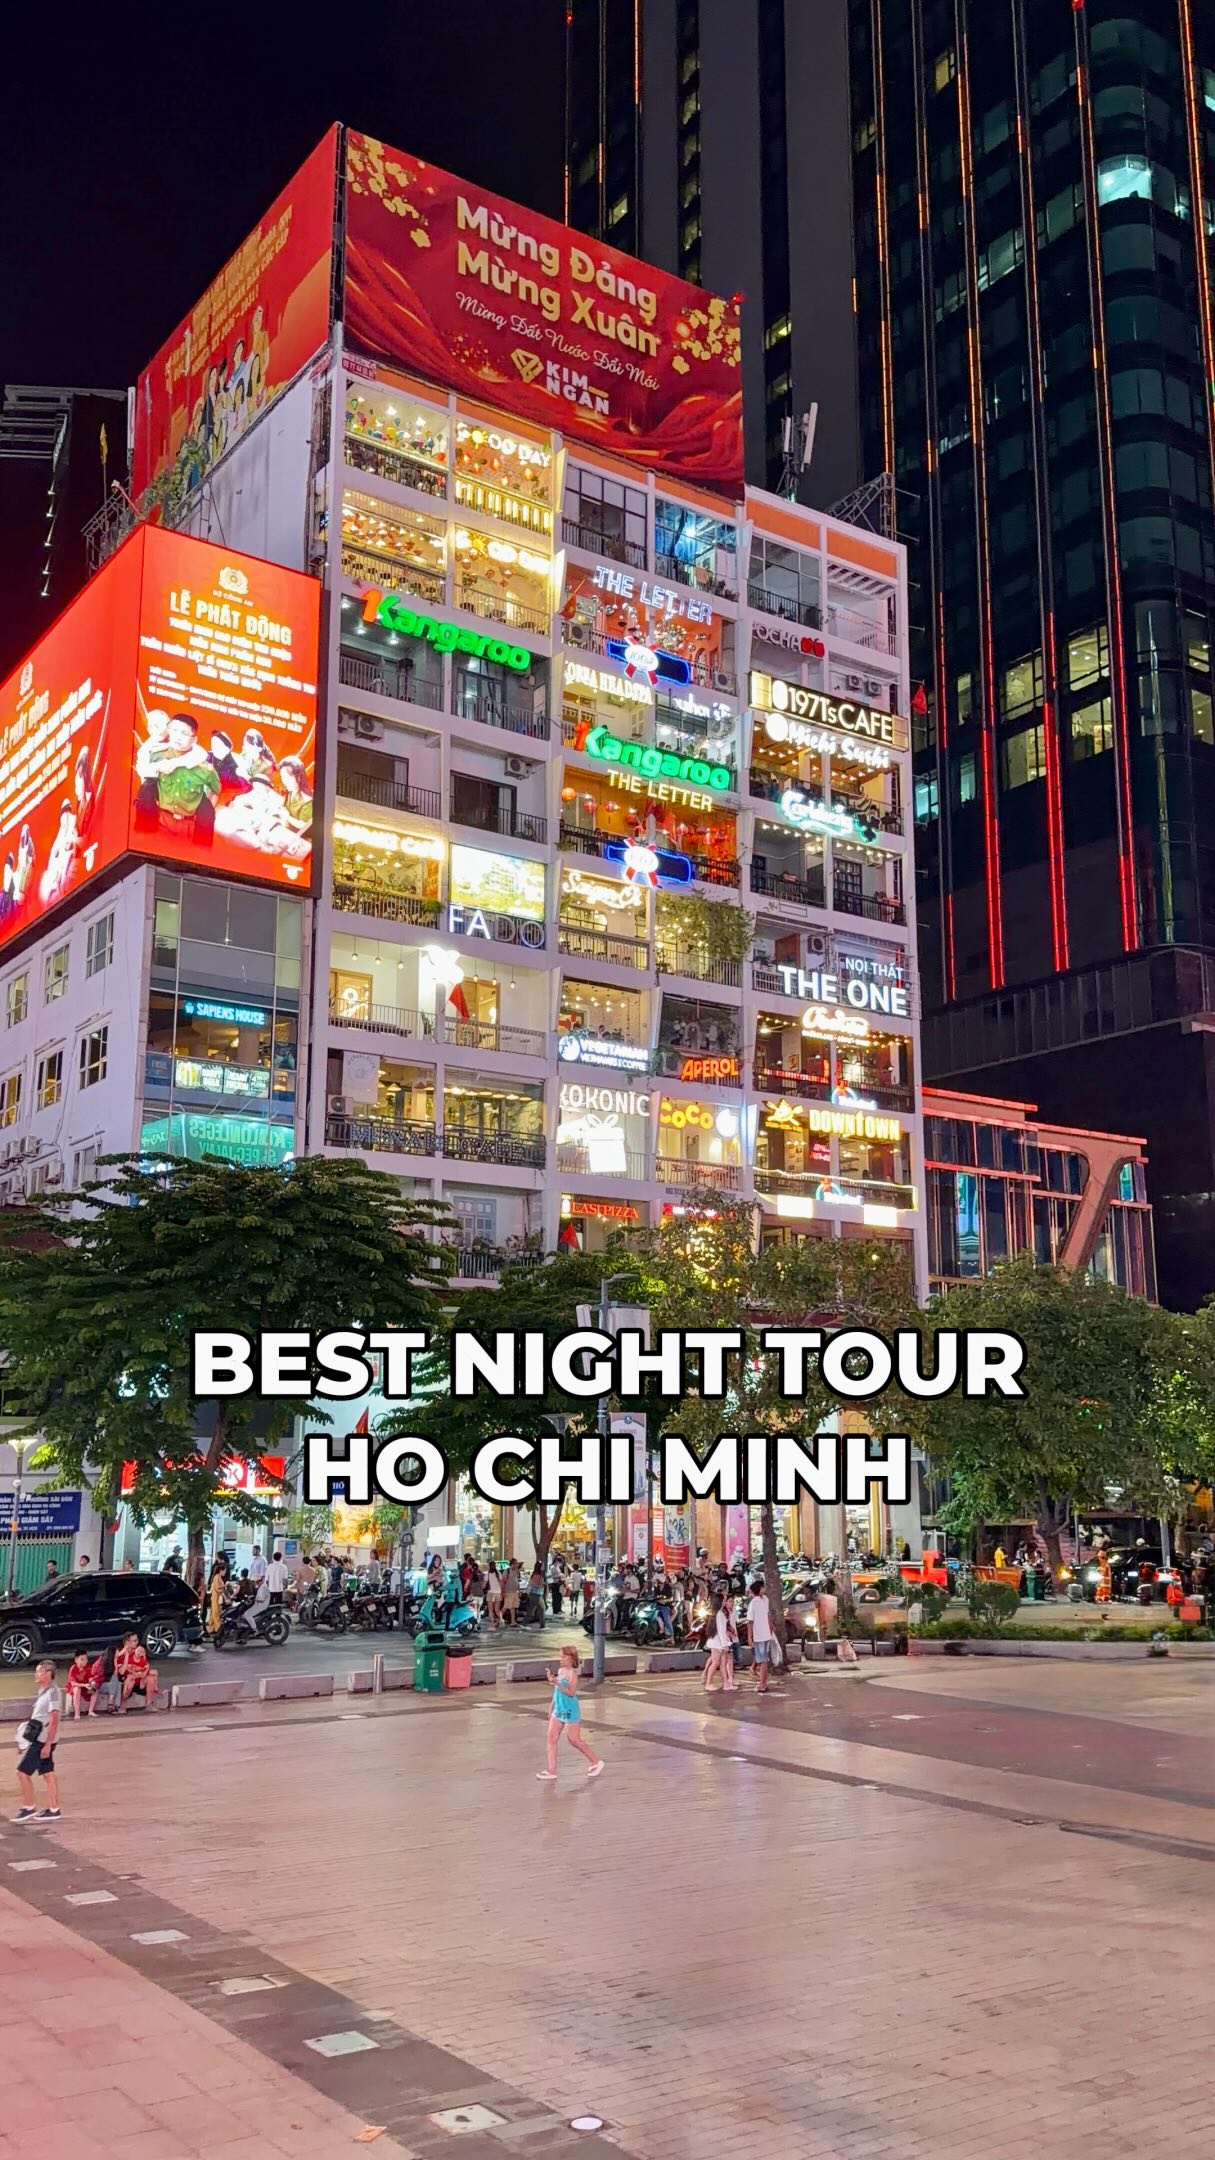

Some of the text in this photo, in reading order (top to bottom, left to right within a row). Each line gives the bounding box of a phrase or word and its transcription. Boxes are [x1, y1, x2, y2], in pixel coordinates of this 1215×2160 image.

[456, 196, 657, 321] Mừng Đảng
[456, 241, 659, 357] Mừng Xuân
[546, 359, 588, 391] KIM
[596, 565, 634, 598] THE
[169, 588, 191, 616] LỄ
[195, 600, 241, 631] PHÁT
[245, 614, 292, 646] ĐỘNG
[362, 588, 531, 671] Kangaroo
[575, 720, 730, 790] Kangaroo
[607, 768, 713, 813] THE LETTER
[449, 905, 545, 949] FADO
[777, 965, 908, 1016] THE ONE
[197, 1002, 265, 1025] SAPIENS HOUSE
[681, 1056, 739, 1082] APEROL
[603, 1205, 639, 1219] PIZZA
